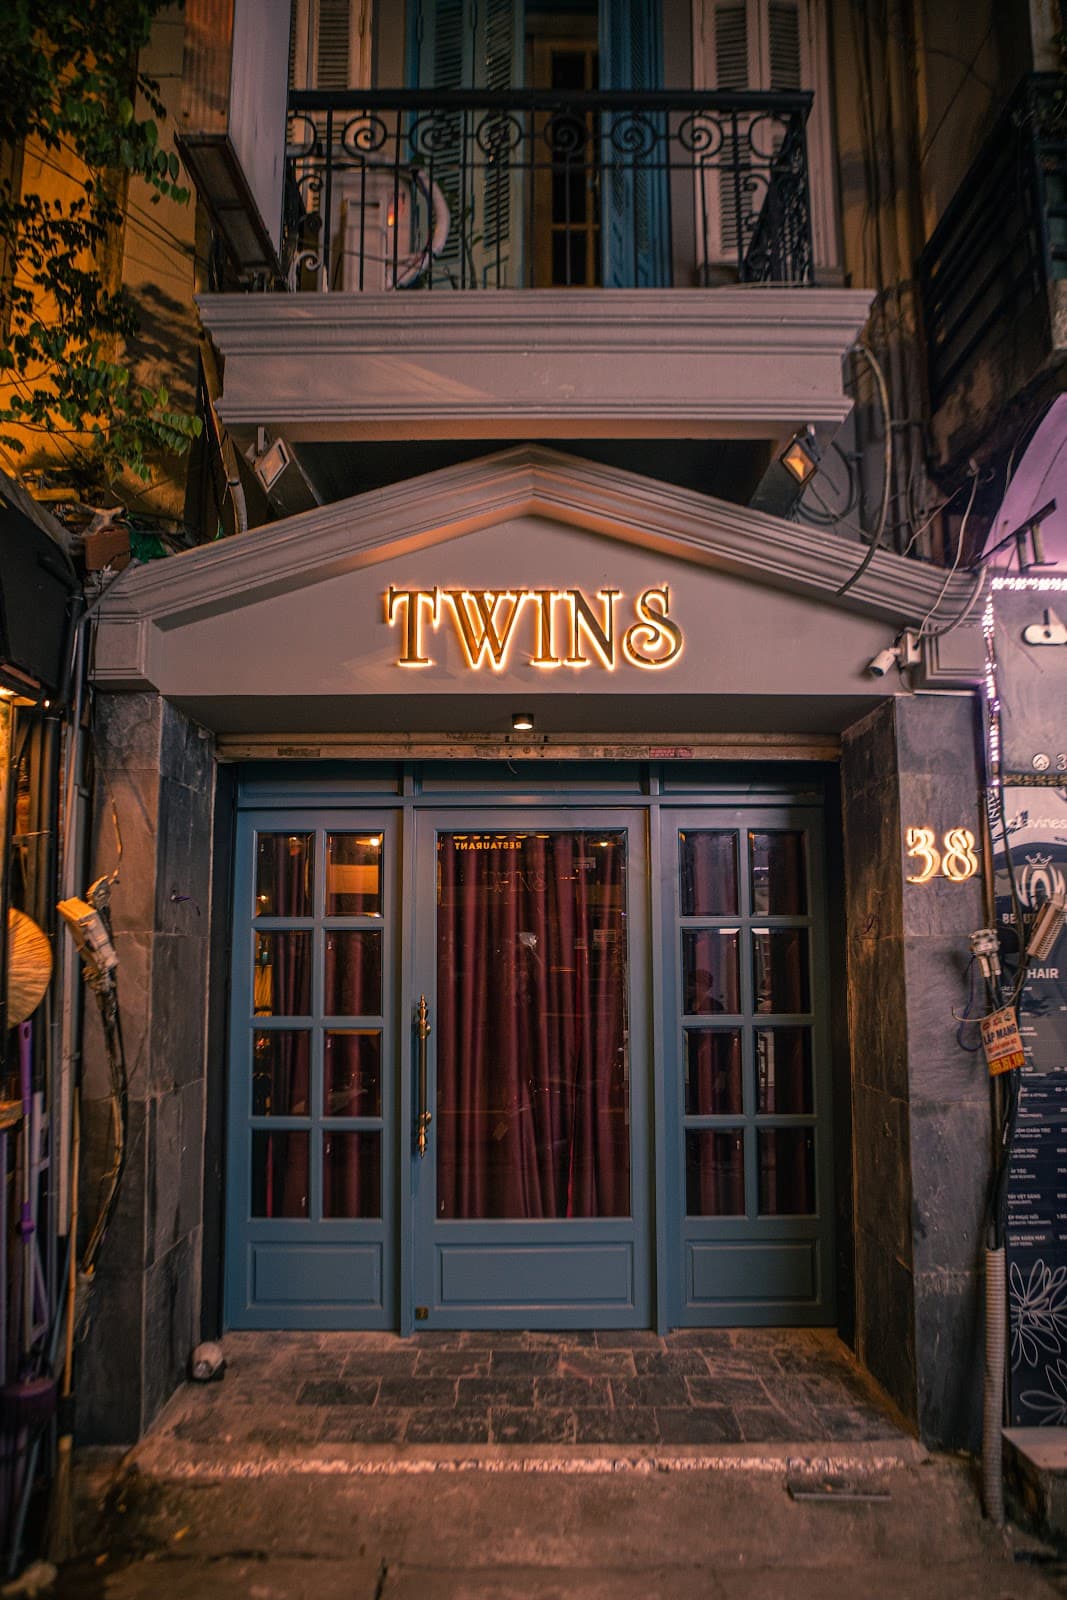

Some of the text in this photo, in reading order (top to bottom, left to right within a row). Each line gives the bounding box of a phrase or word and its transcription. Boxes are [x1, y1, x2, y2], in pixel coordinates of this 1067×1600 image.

[386, 585, 683, 669] TWINS
[906, 827, 979, 883] 38
[1026, 967, 1060, 979] HAIR
